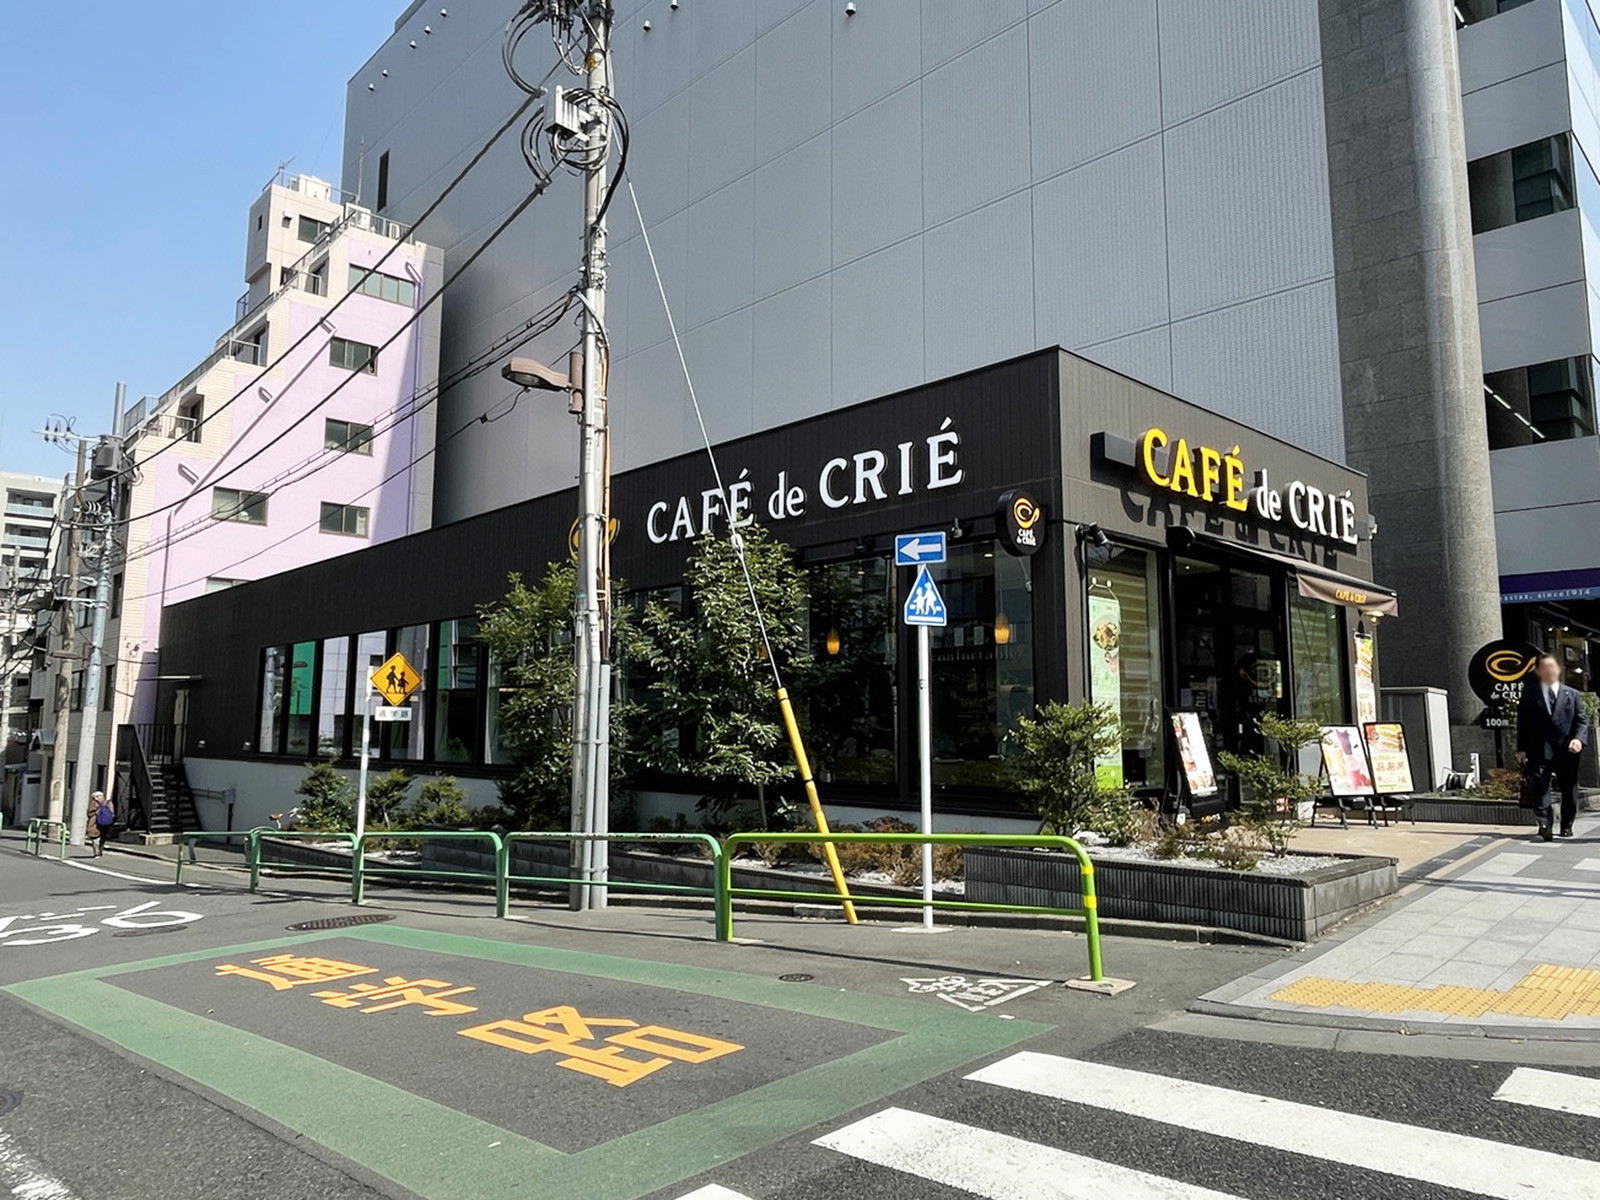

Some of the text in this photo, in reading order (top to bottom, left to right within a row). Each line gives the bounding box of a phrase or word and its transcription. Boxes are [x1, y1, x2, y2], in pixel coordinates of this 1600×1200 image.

[646, 416, 965, 544] CAFÉ de CRIÉ
[1142, 427, 1358, 545] CAFÉ de CRIÉ
[215, 954, 746, 1088] 通学路
